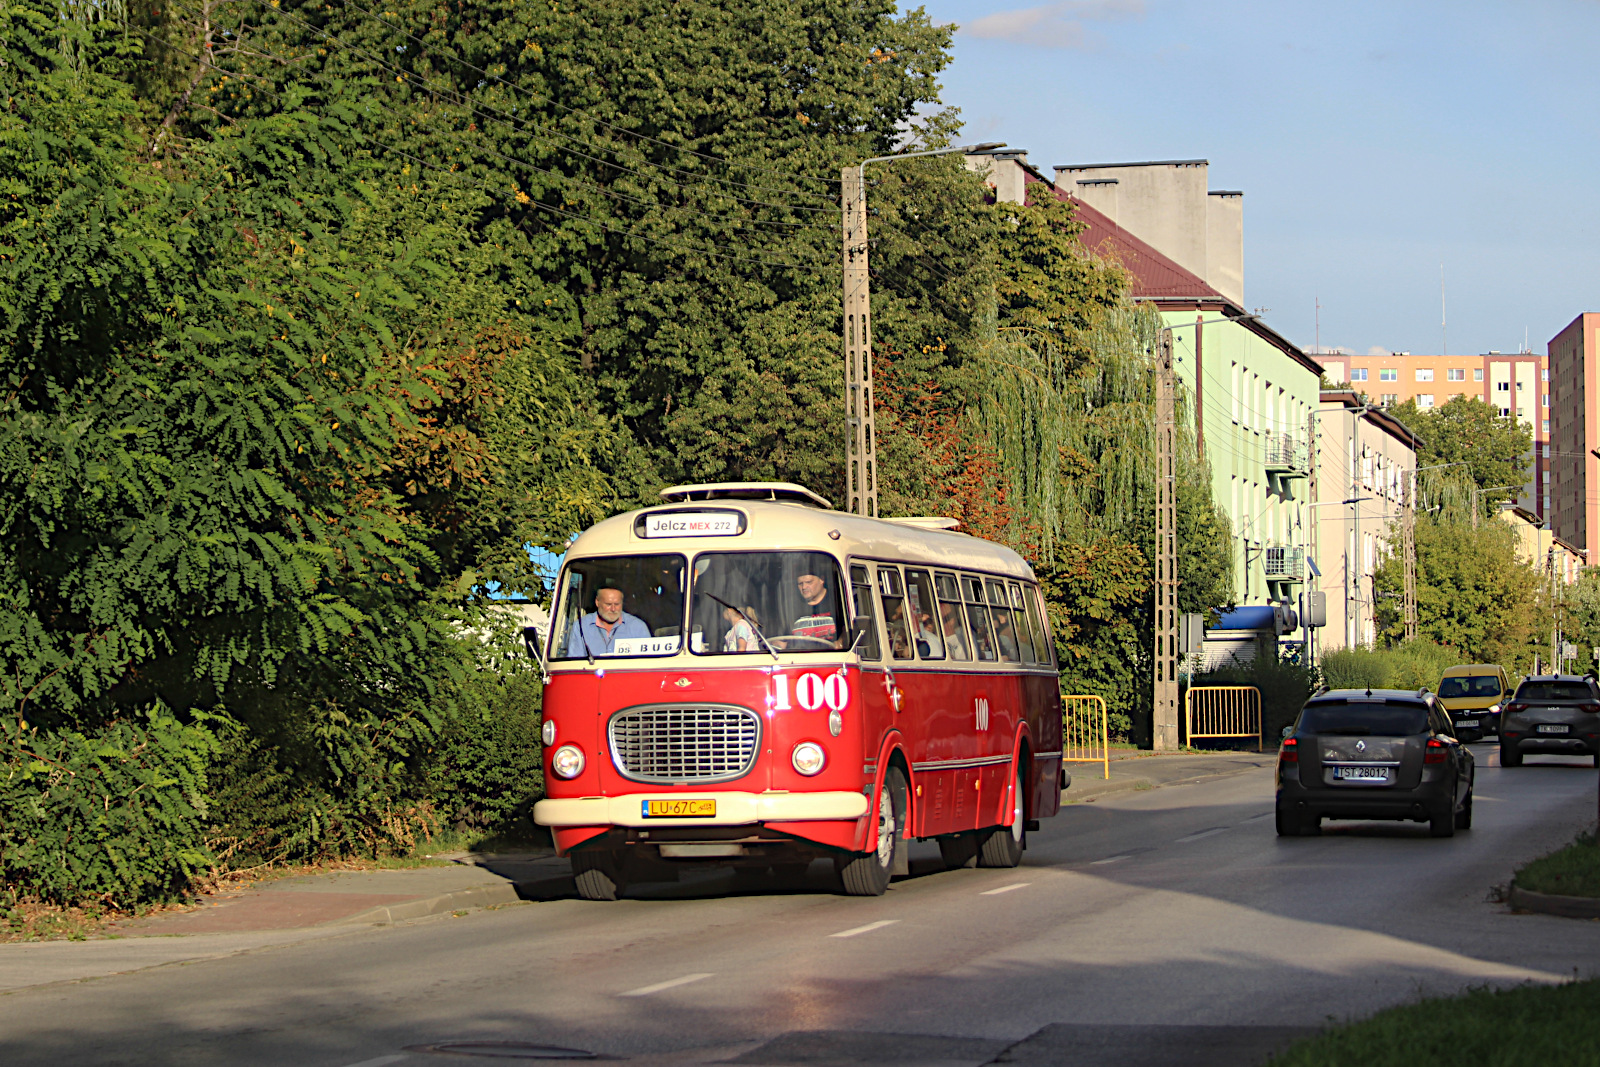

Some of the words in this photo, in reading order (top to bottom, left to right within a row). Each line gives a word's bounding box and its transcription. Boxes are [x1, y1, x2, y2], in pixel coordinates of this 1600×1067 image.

[653, 520, 686, 531] Jelcz
[689, 522, 710, 530] MEX
[714, 522, 731, 530] 272
[772, 672, 848, 711] 100
[974, 698, 989, 731] 100
[1339, 768, 1356, 777] TST
[1359, 768, 1386, 777] 28012
[651, 802, 669, 814] LU
[673, 802, 697, 814] 67C
